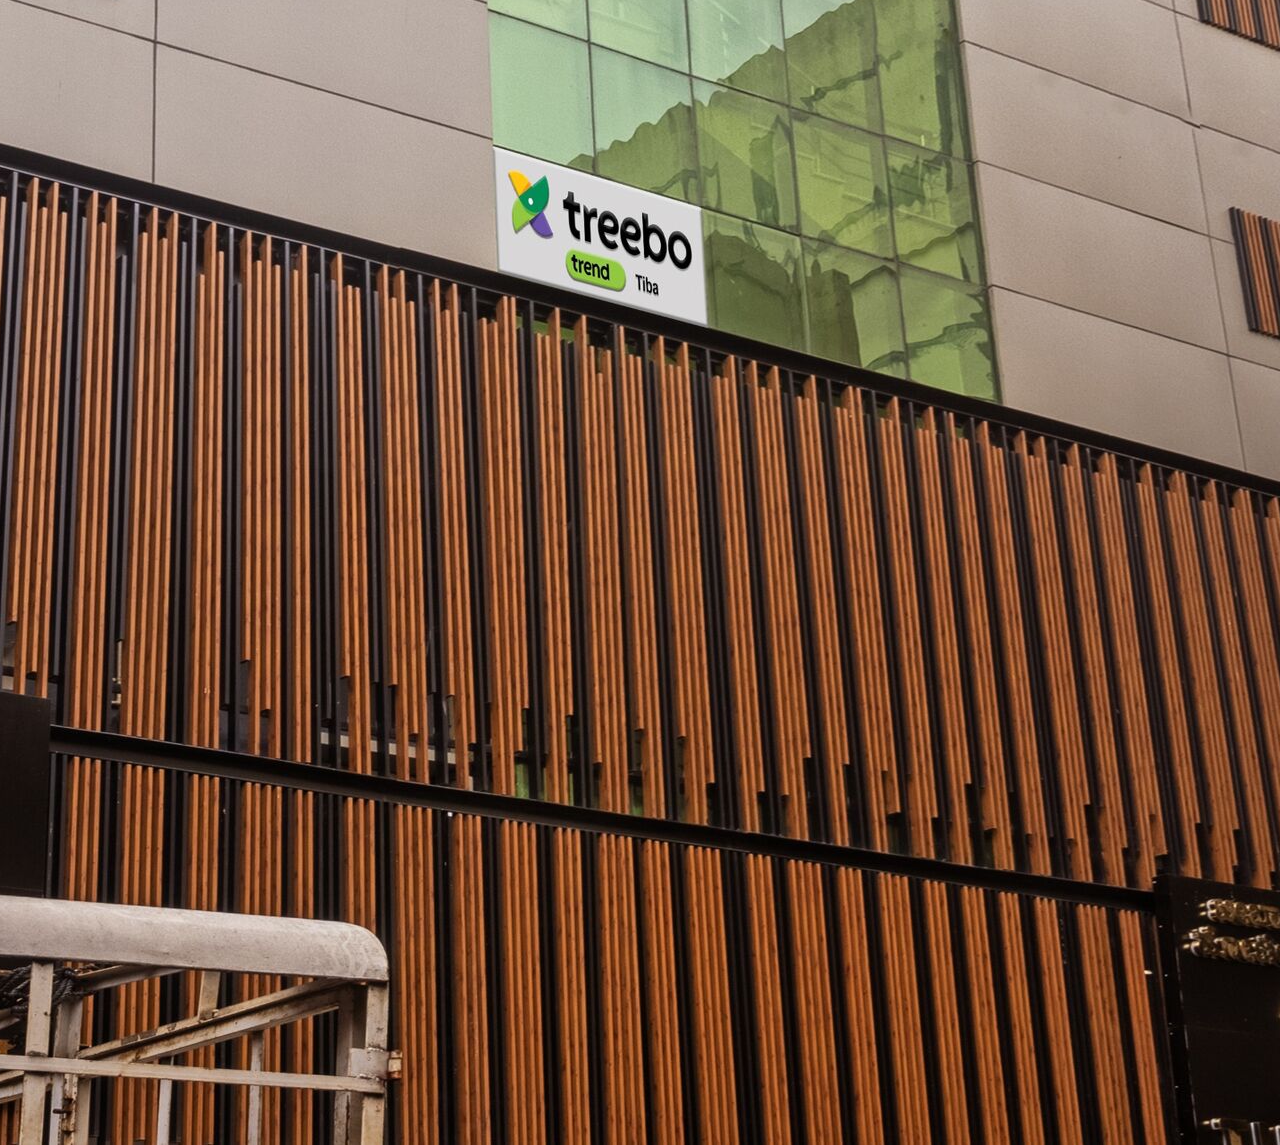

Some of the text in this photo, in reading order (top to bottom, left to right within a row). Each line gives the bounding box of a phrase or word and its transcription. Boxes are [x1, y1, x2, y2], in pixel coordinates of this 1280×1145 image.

[563, 191, 692, 269] treebo
[570, 254, 610, 281] trend
[635, 274, 659, 296] Tiba
